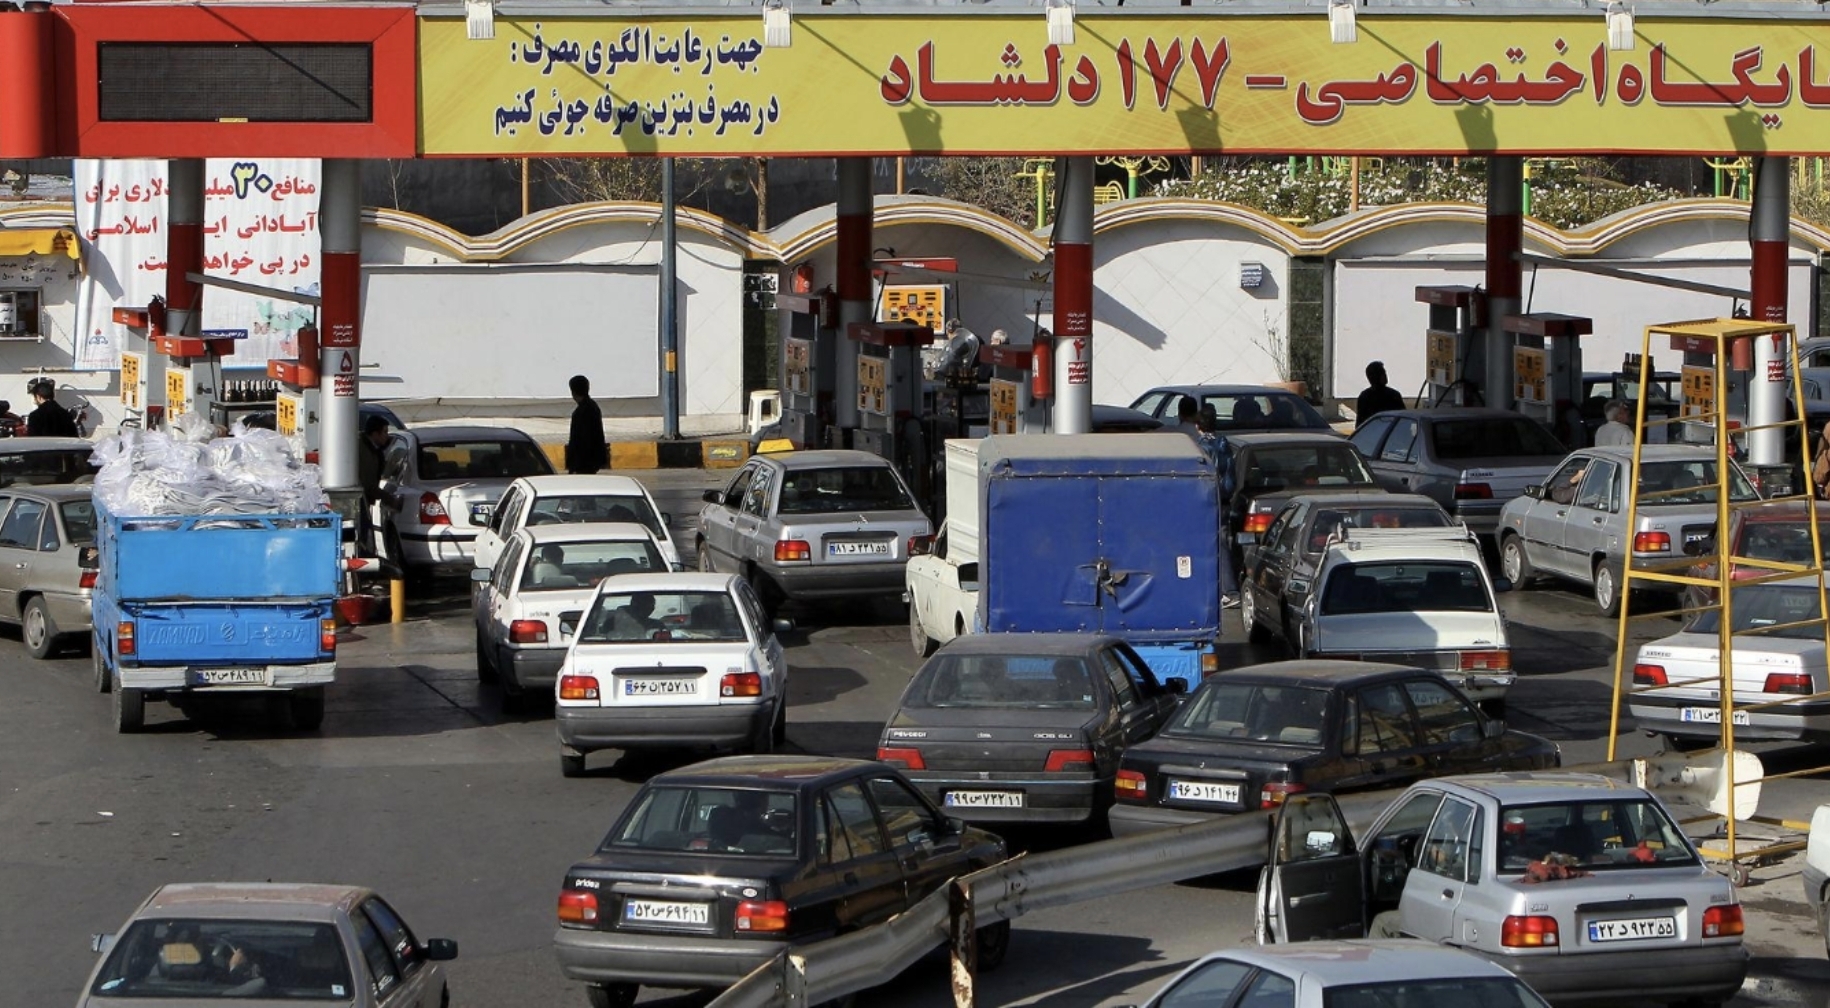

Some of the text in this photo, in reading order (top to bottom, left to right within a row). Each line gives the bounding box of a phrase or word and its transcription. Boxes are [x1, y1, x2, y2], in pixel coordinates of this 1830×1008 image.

[523, 22, 580, 74] مصرف
[585, 26, 650, 74] الگوی
[654, 27, 711, 74] رعایت
[716, 33, 763, 73] جهت
[879, 39, 1101, 105] دلشاد
[1115, 36, 1232, 111] ۱۷۷
[1296, 37, 1610, 123] اختصاصی
[494, 88, 536, 136] کنیم
[593, 82, 639, 136] صرفه
[641, 91, 694, 136] بنزین
[698, 83, 751, 135] مصرف
[753, 95, 779, 135] در
[85, 176, 120, 203] برای
[230, 162, 273, 200] ۳۰
[270, 175, 316, 201] منافع
[85, 215, 158, 241] اسلامی
[236, 210, 317, 240] آبادانی
[259, 252, 284, 276] پی
[289, 252, 311, 274] در
